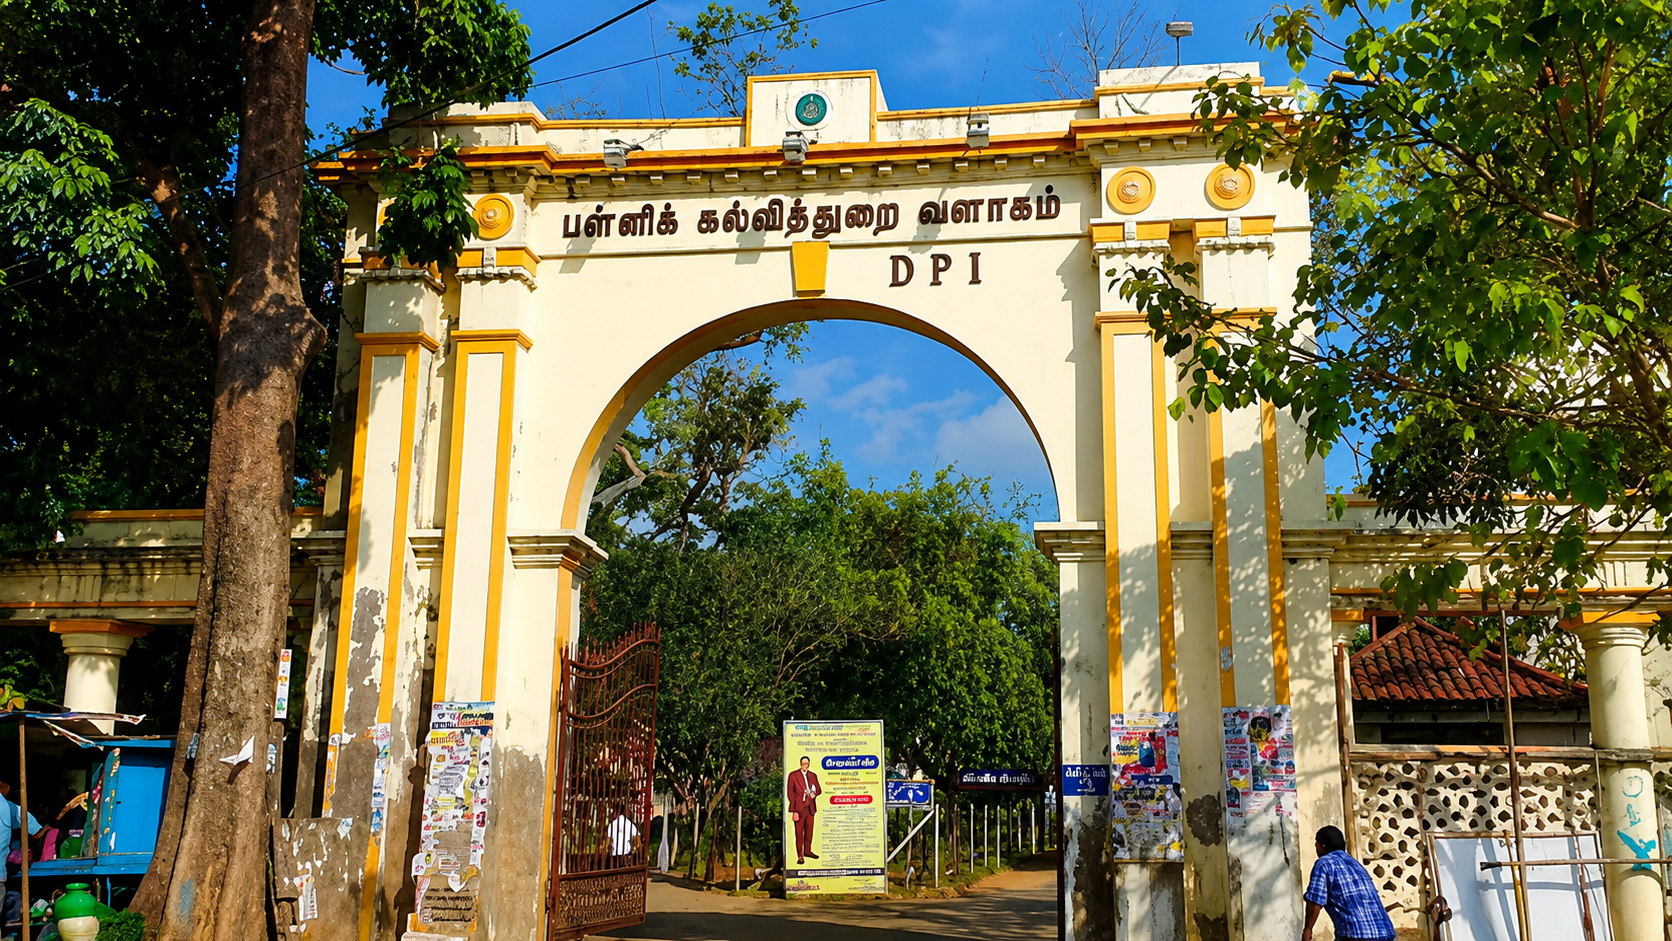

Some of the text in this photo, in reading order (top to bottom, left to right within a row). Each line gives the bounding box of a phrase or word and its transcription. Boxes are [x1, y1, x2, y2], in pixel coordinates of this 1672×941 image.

[563, 184, 1061, 239] பள்ளிக் கல்வித்துறை வளாகம்
